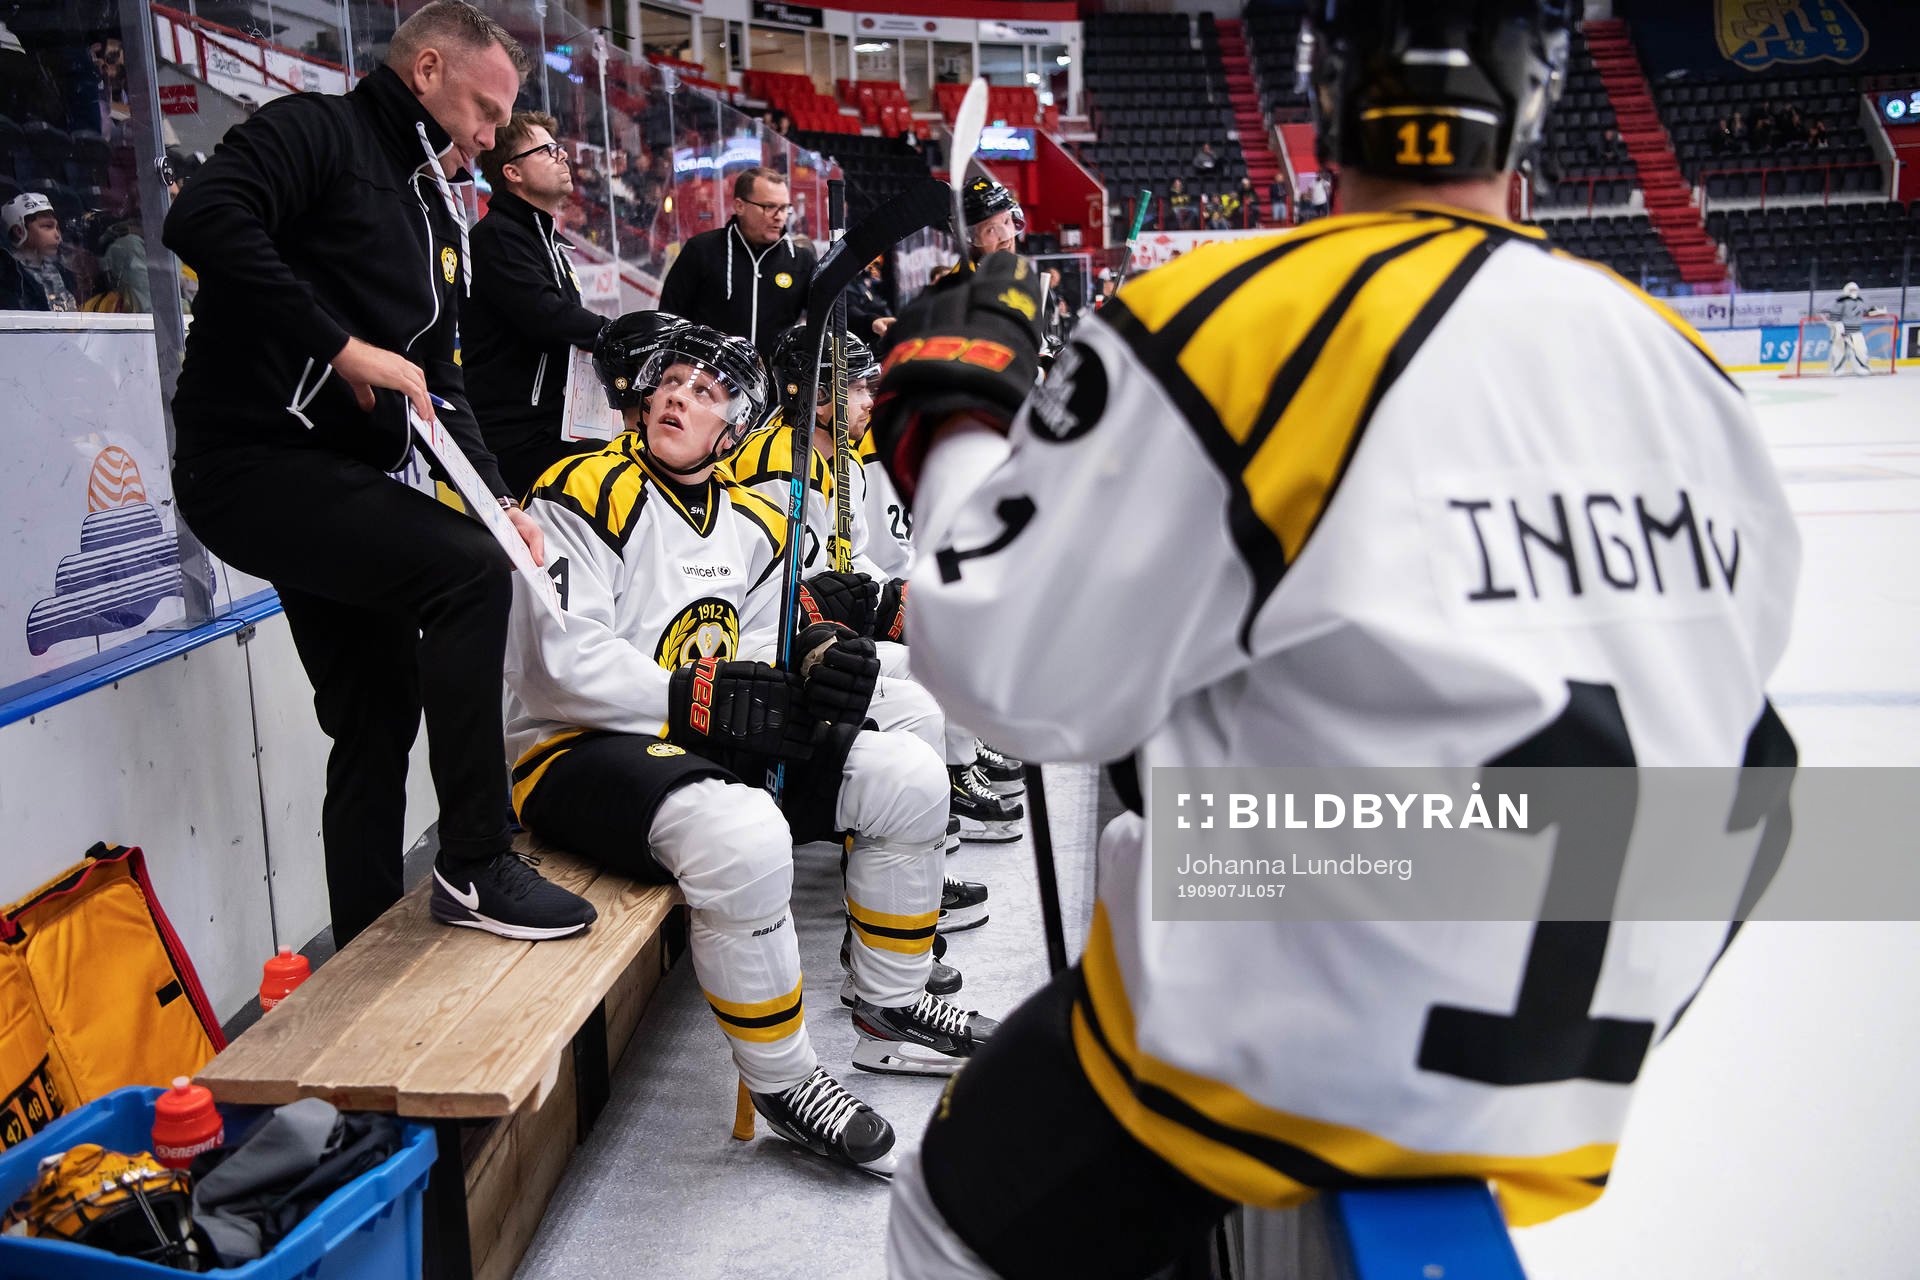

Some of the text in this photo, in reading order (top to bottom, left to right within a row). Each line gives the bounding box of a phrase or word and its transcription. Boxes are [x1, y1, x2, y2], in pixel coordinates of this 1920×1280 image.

[1395, 121, 1454, 165] 11
[685, 334, 718, 349] BAUER
[682, 565, 717, 578] unicef
[697, 603, 724, 620] 1912
[751, 915, 788, 938] BAUER
[906, 1028, 935, 1043] BAUER
[28, 1096, 43, 1122] 48
[6, 1117, 22, 1145] 47
[168, 1136, 216, 1157] ENERVIT
